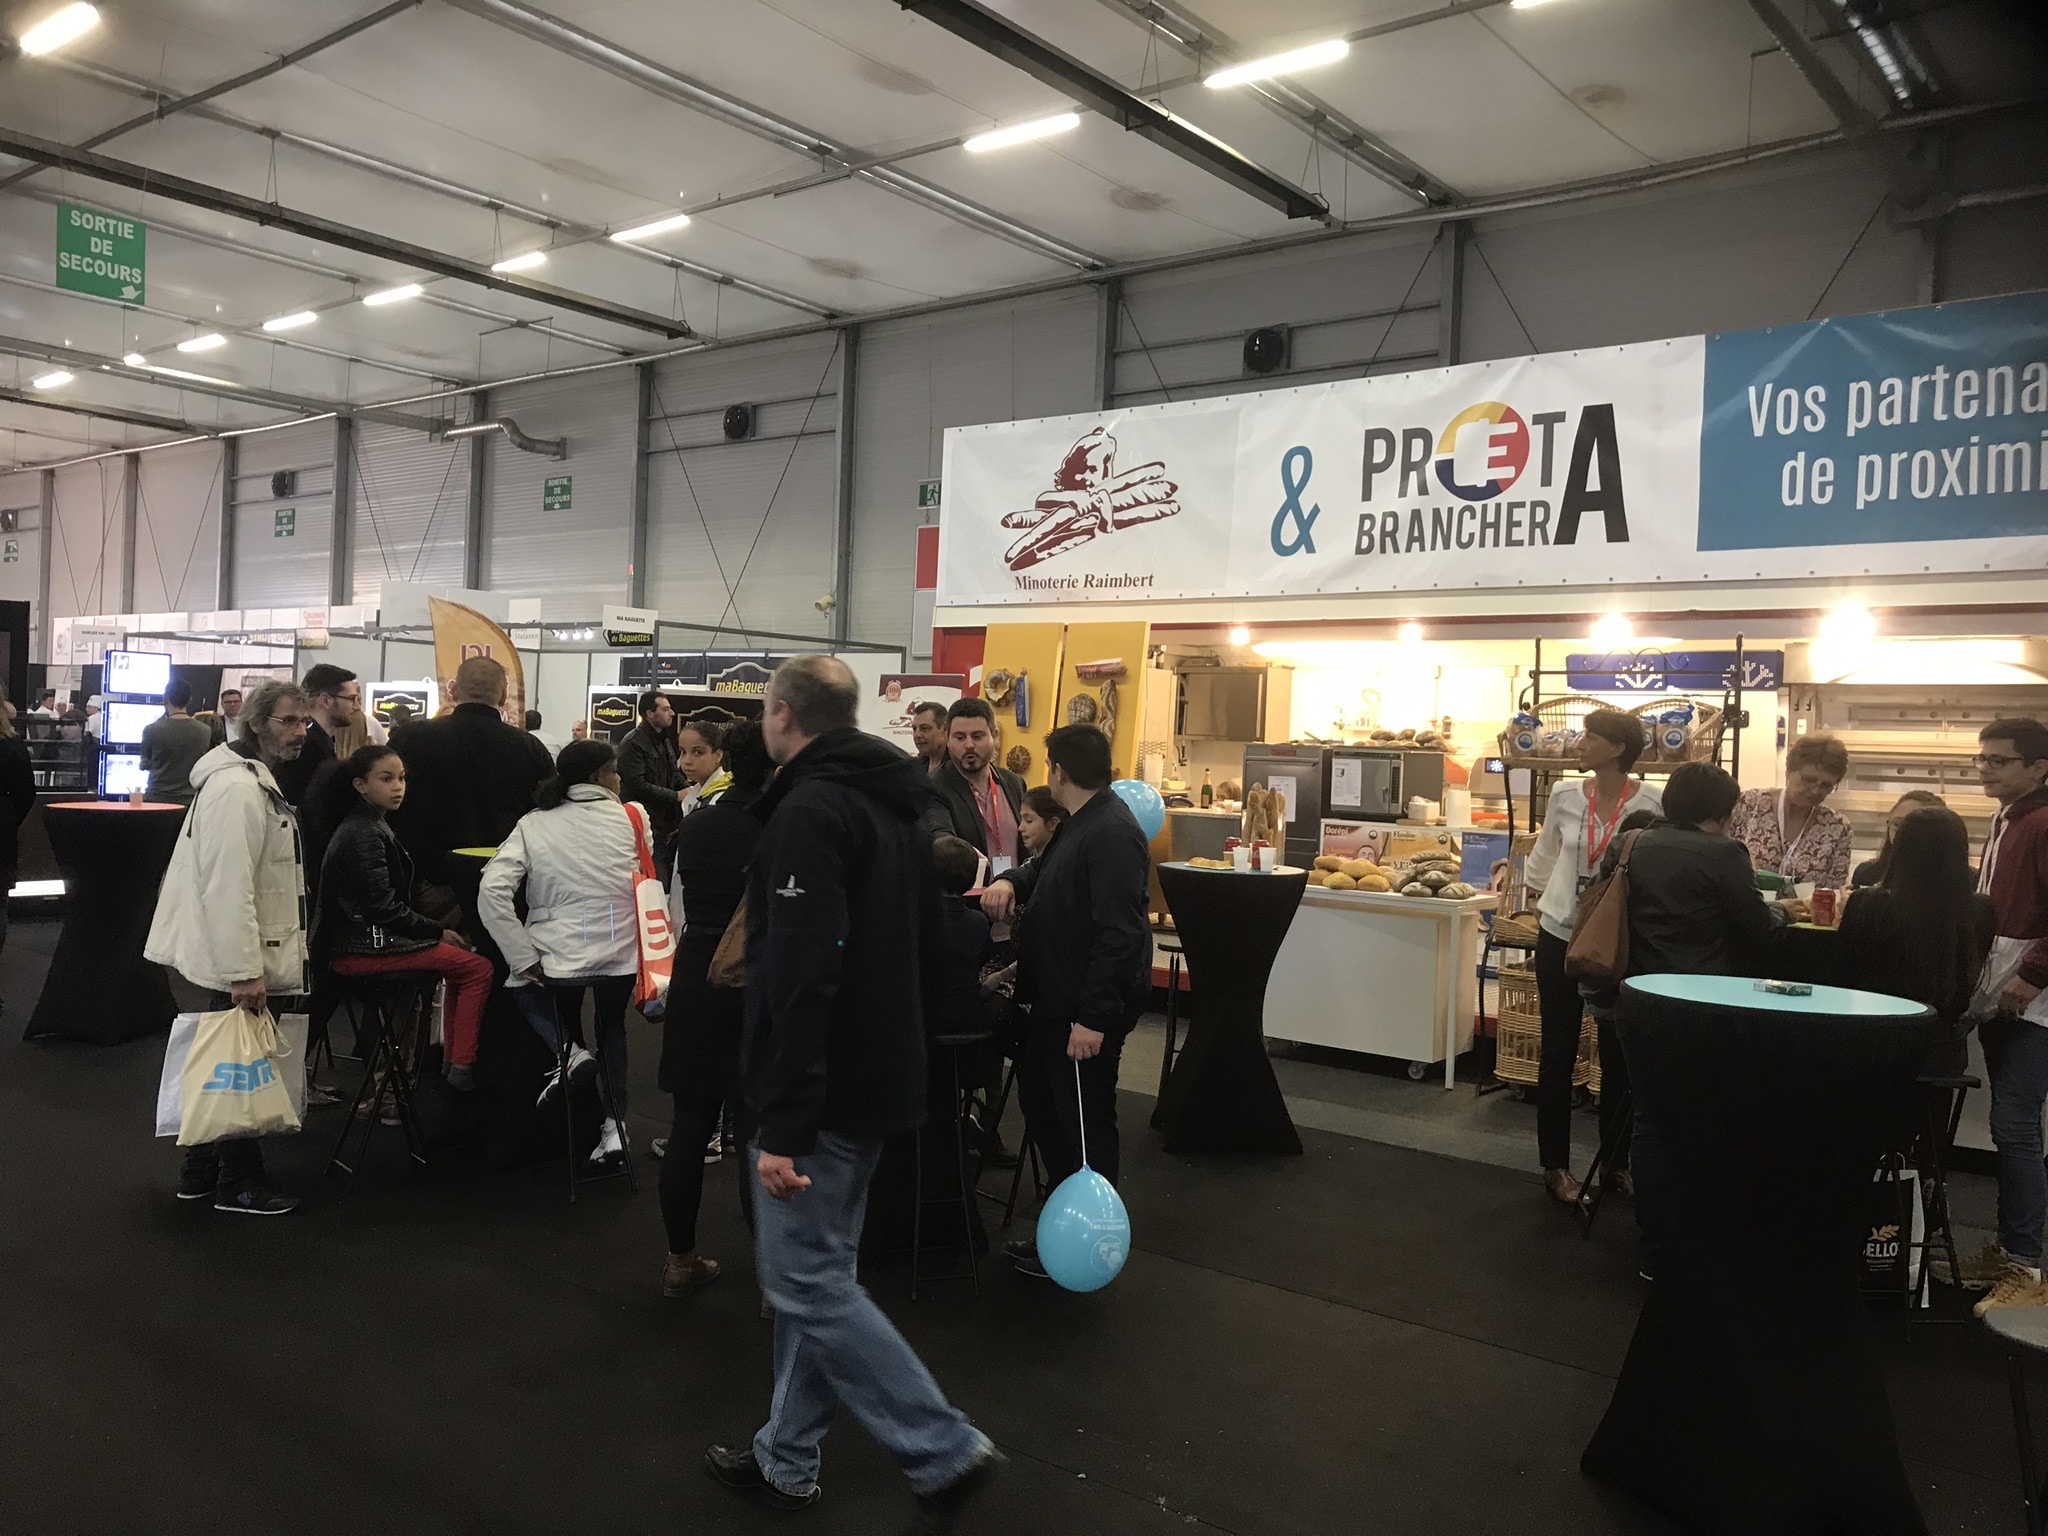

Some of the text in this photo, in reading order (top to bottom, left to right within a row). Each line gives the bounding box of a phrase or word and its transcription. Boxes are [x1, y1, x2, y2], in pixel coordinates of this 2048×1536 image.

[70, 209, 134, 239] SORTIE
[90, 236, 113, 256] DE
[59, 251, 142, 284] SECOURS
[1748, 361, 2048, 437] Vos partena
[1781, 430, 2048, 510] de proximi
[1270, 445, 1321, 557] &
[1015, 572, 1155, 590] Minoterie Raimbert
[619, 633, 650, 644] Baguettes
[1325, 826, 1349, 835] Dorépi
[1863, 1242, 1899, 1257] ELLO
